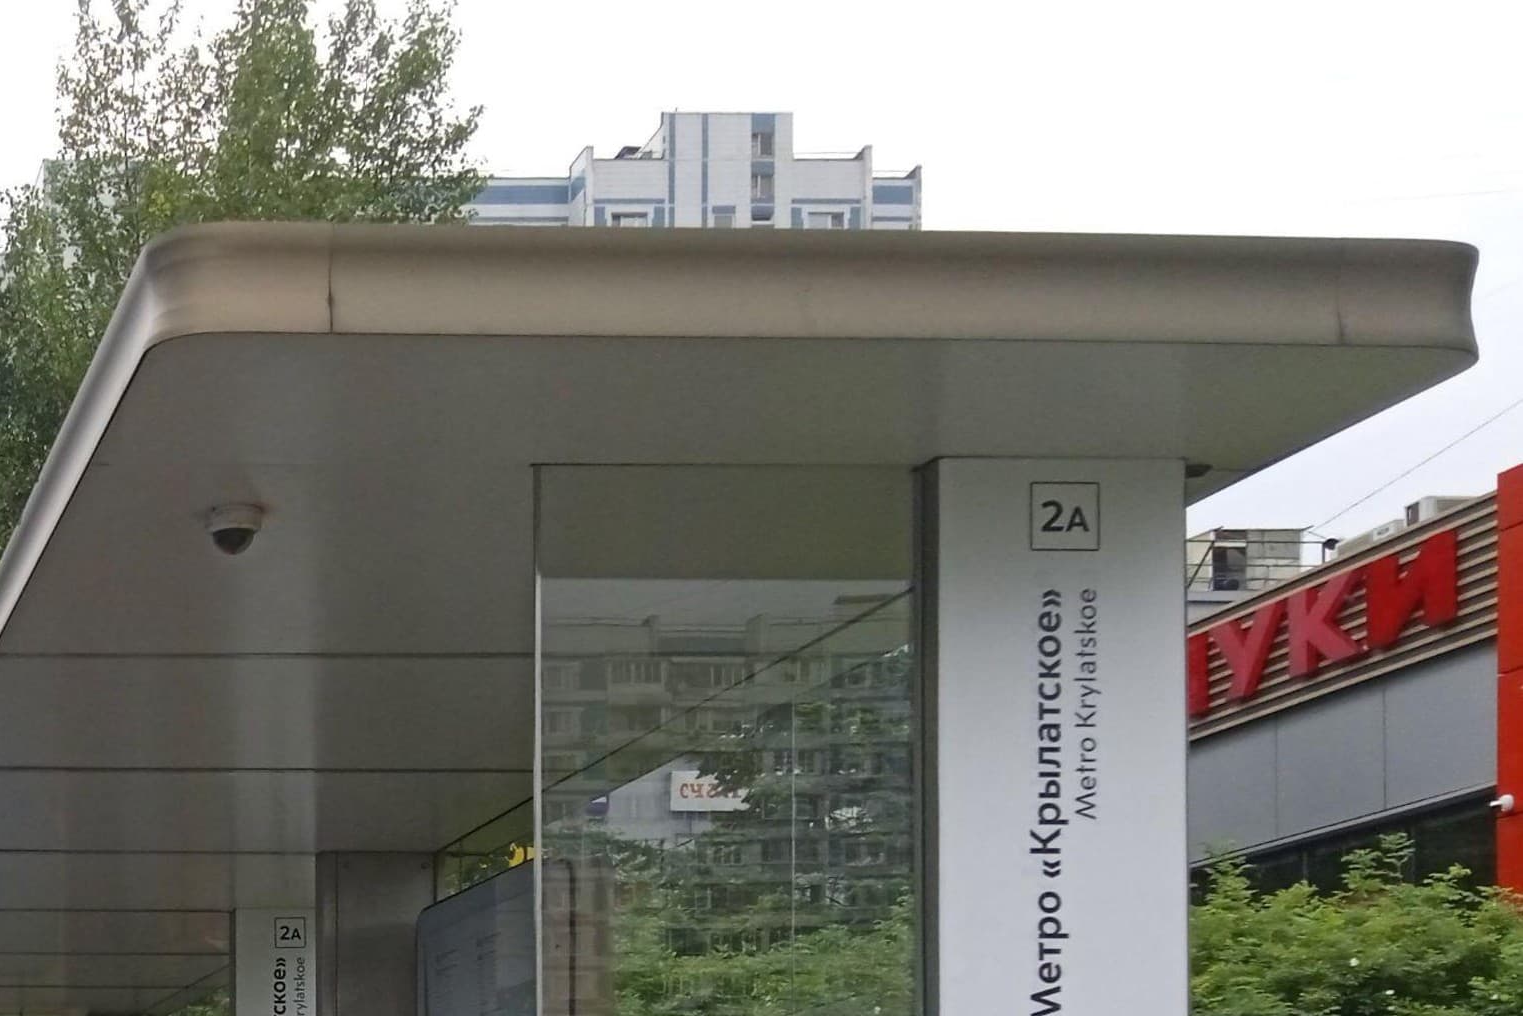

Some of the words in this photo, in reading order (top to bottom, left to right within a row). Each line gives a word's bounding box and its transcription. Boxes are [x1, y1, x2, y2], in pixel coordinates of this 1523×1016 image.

[1074, 587, 1102, 729] Krylatskoe
[1030, 588, 1070, 879] «Крылатское»
[1074, 736, 1098, 821] Metro
